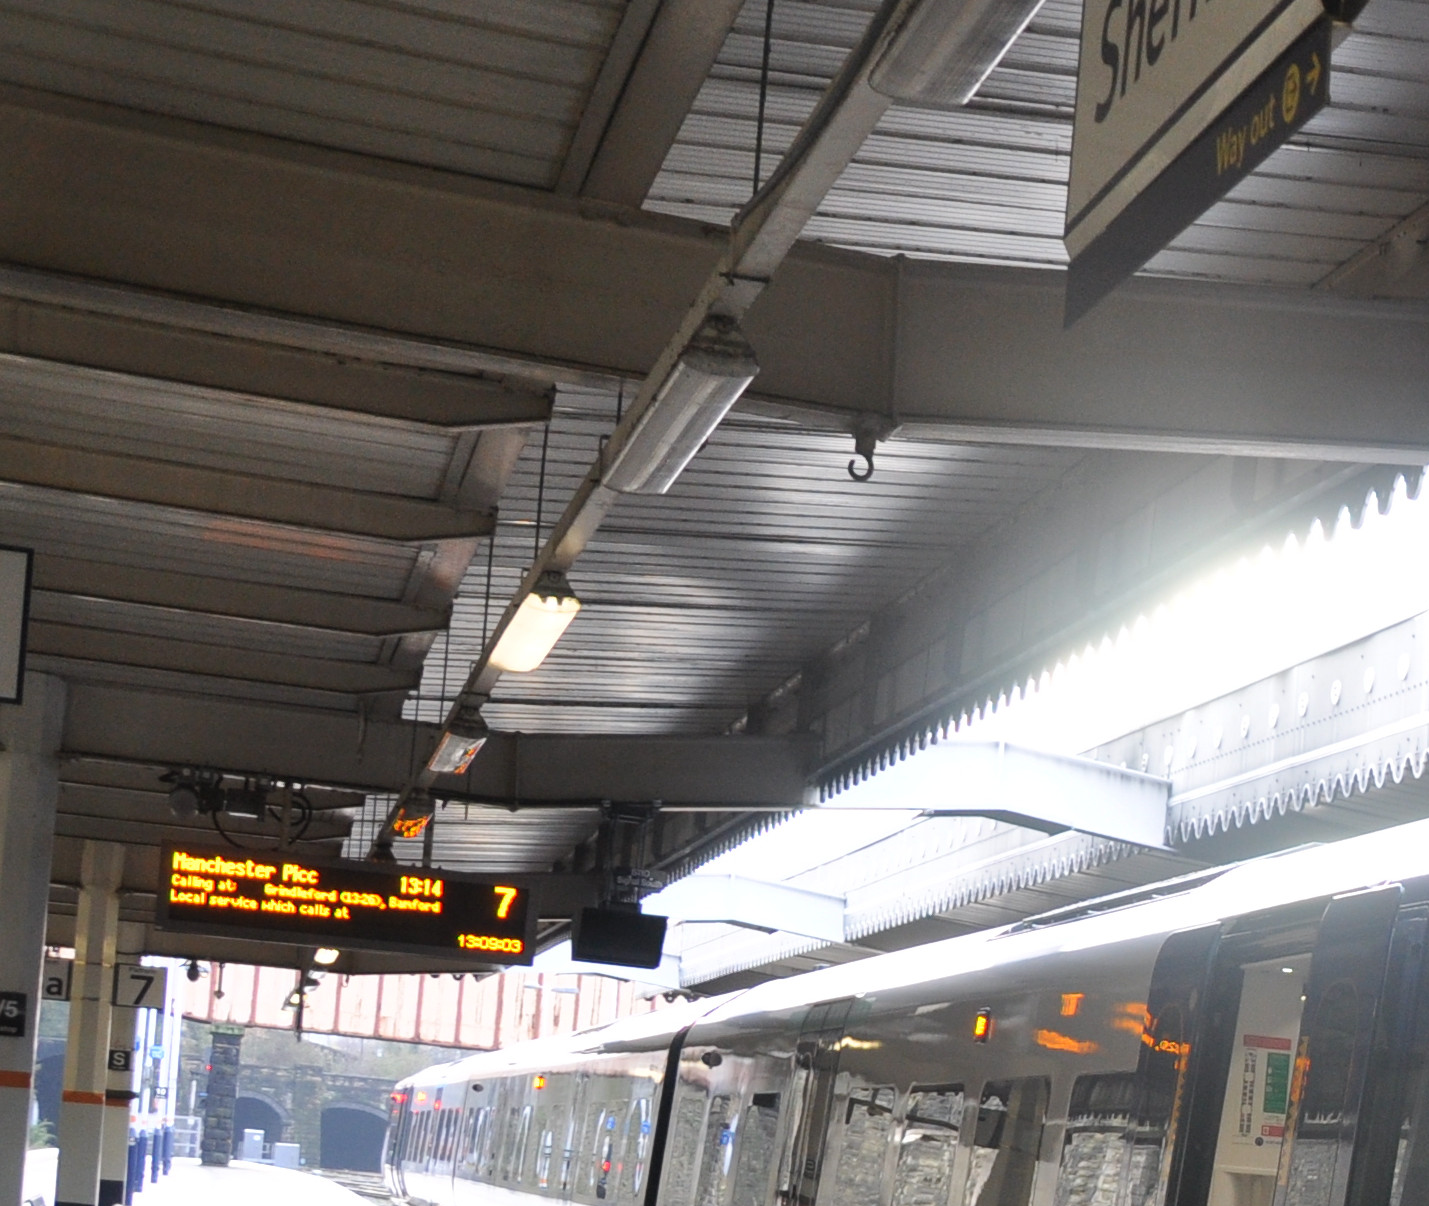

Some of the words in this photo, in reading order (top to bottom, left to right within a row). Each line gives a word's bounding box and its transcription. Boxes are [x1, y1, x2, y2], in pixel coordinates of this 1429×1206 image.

[1216, 127, 1248, 175] Way
[1251, 94, 1276, 145] out
[171, 851, 277, 880] Manchester
[281, 863, 319, 884] Picc
[171, 873, 216, 892] Calling
[264, 883, 339, 903] Grindleford
[388, 896, 442, 914] Bamford
[400, 875, 444, 898] 13:14
[494, 885, 518, 919] 7
[170, 888, 207, 905] Local
[208, 895, 259, 911] service
[260, 899, 297, 914] which
[299, 903, 331, 918] calls
[333, 906, 351, 920] at
[457, 933, 523, 954] 13:09:03
[46, 977, 63, 996] a
[130, 974, 155, 1005] 7
[112, 1052, 126, 1066] S
